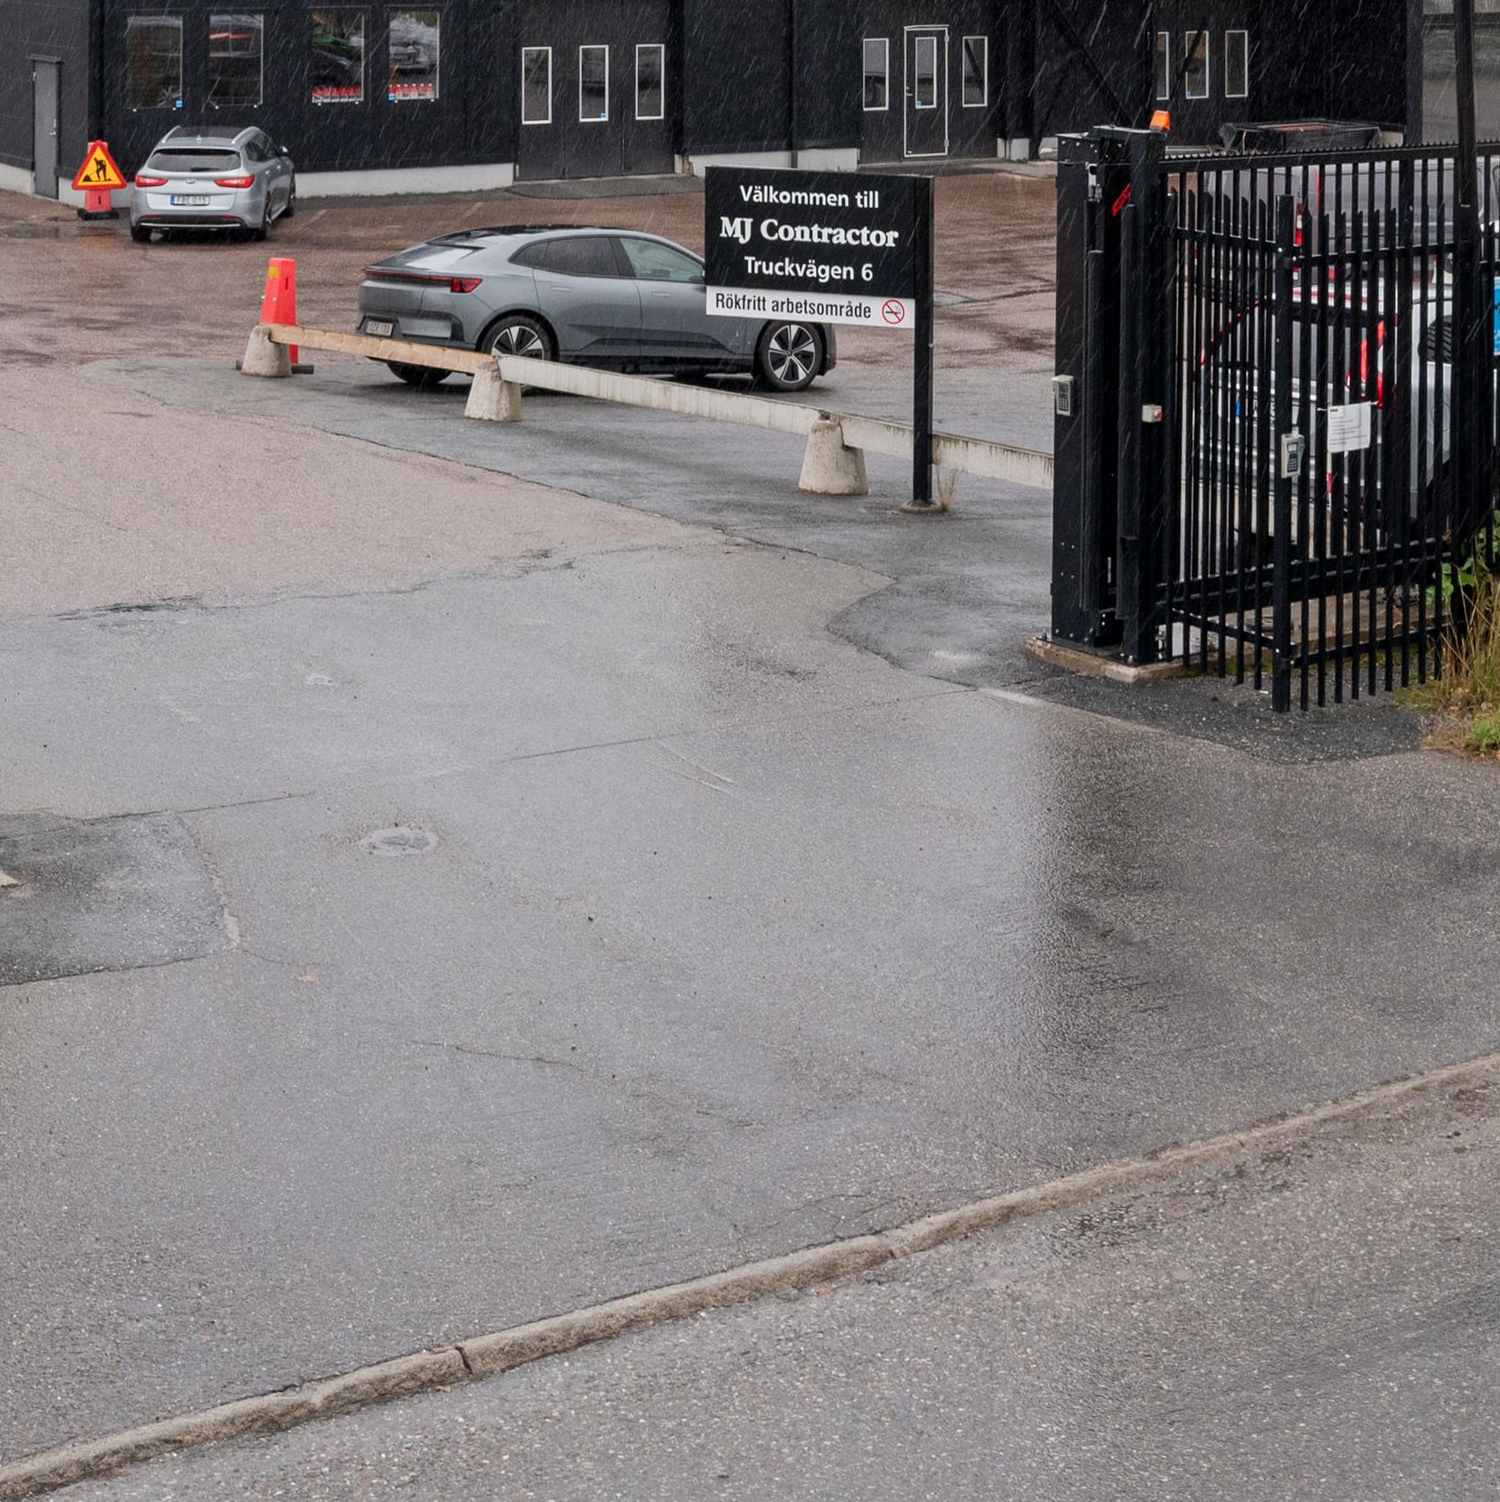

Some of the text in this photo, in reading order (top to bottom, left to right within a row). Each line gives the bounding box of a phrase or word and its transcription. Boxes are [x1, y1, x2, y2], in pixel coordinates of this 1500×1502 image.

[740, 185, 880, 209] Välkommen till
[719, 216, 899, 247] MJ Contractor
[744, 256, 873, 283] Truckvägen 6
[715, 293, 872, 319] Rökfritt arbetsområde
